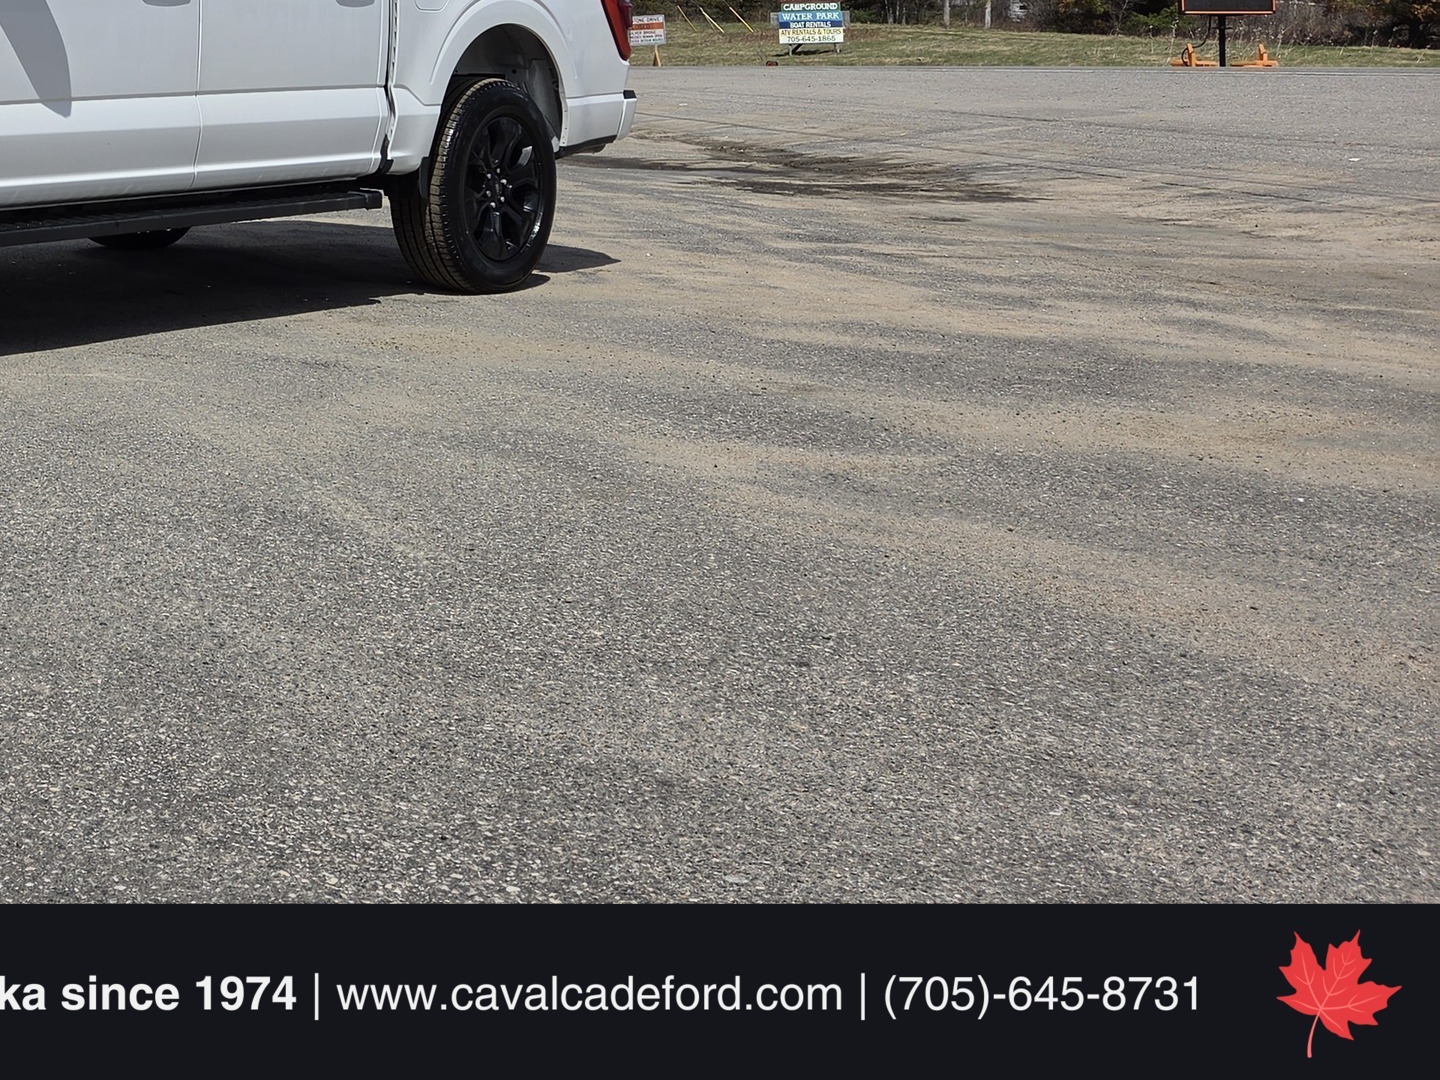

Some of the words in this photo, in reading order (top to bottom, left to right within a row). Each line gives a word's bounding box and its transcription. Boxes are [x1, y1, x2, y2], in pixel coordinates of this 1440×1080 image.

[783, 3, 838, 11] CAMPGROUND
[781, 12, 813, 20] WATER
[815, 12, 839, 20] PARK
